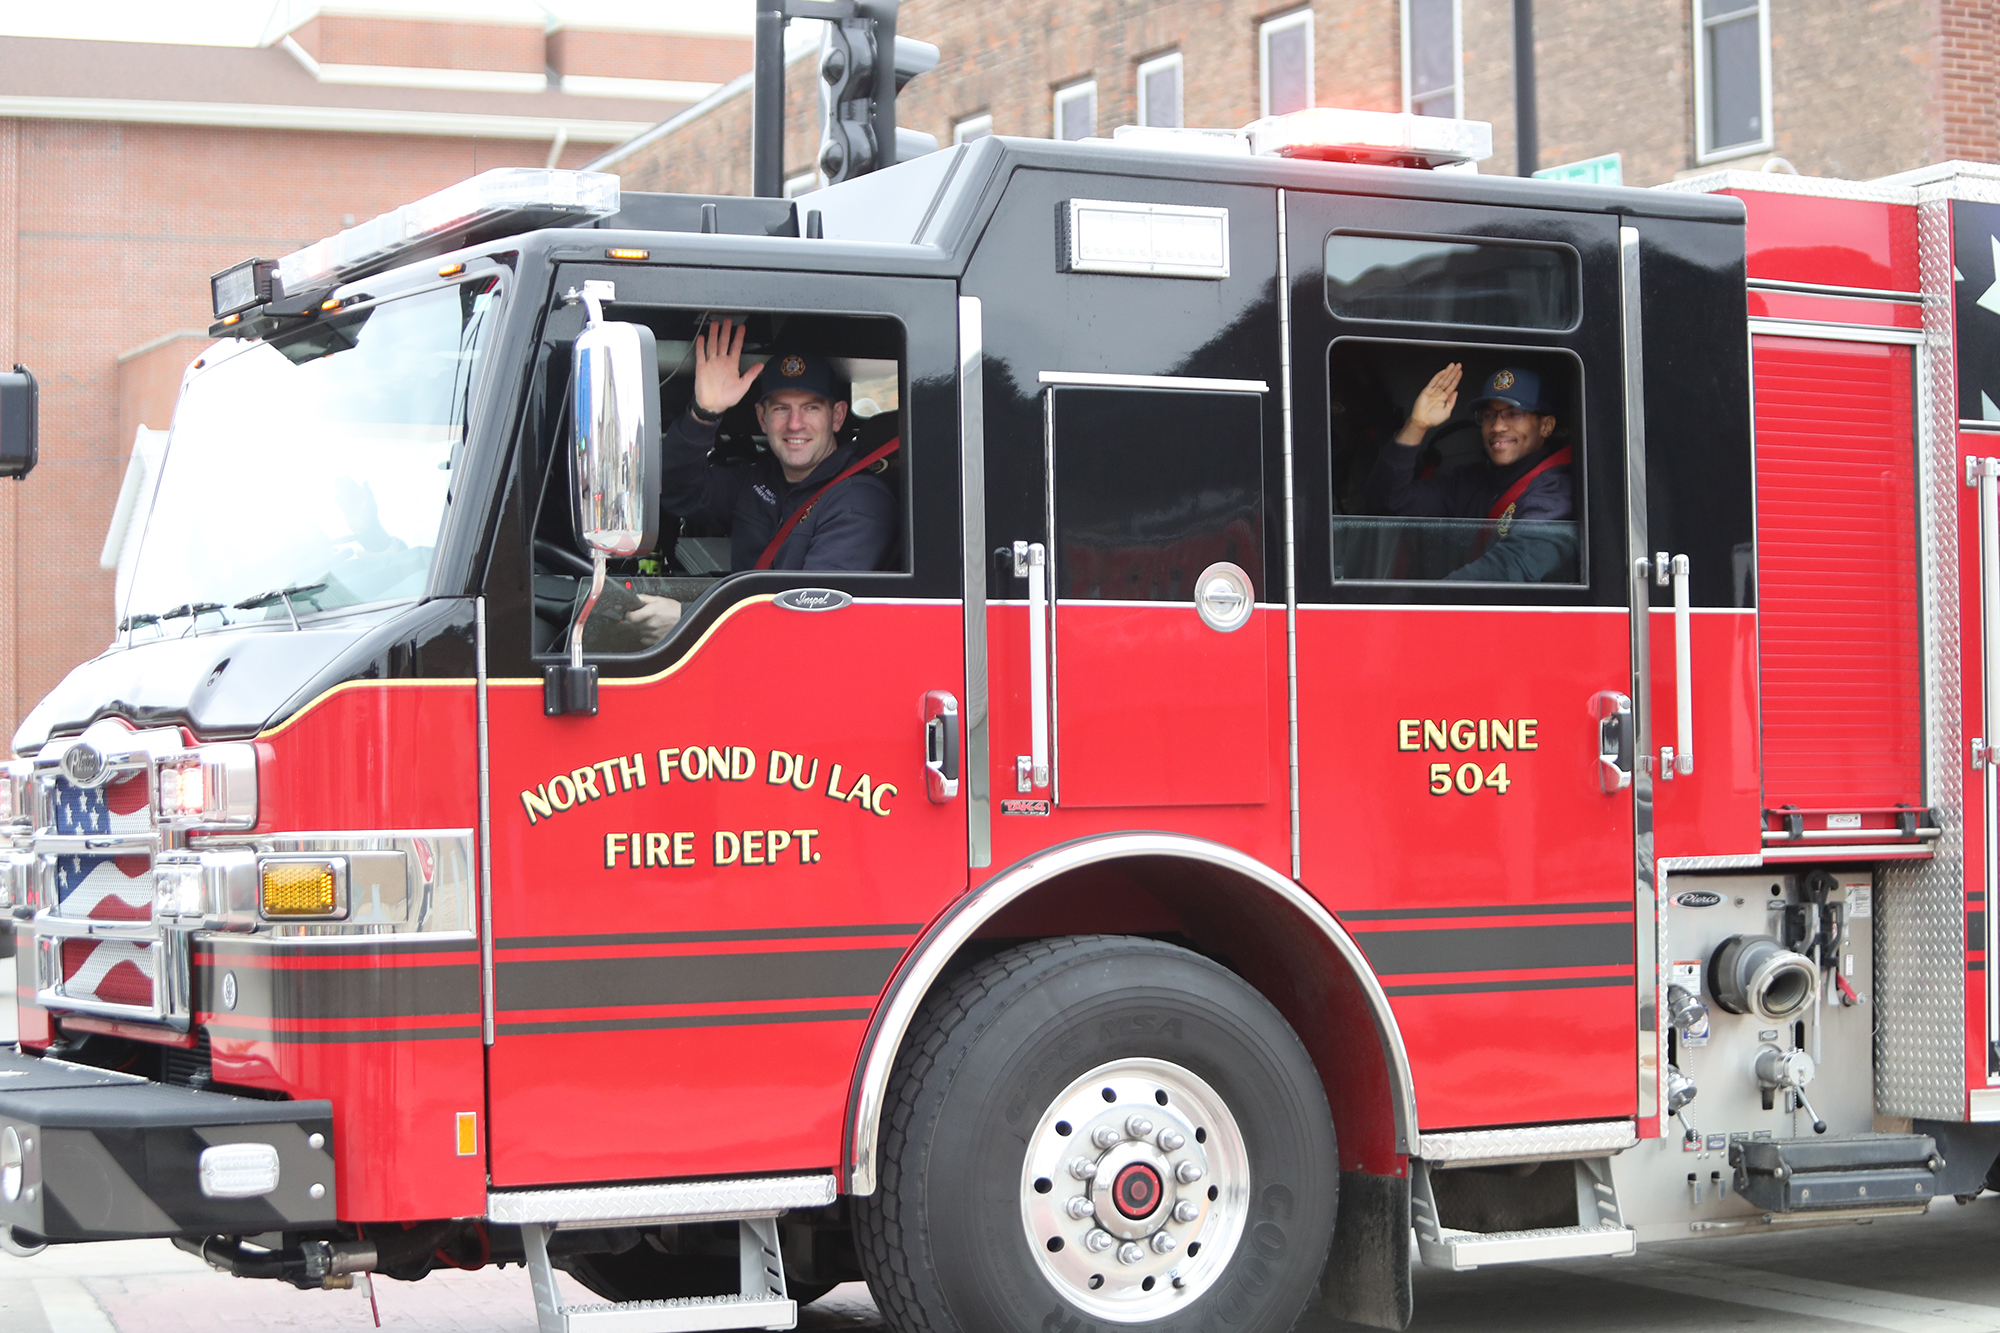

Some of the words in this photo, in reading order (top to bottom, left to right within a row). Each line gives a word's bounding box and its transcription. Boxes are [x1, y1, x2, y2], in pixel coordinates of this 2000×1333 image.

[795, 591, 830, 609] Impel
[1398, 718, 1539, 751] ENGINE
[519, 752, 647, 826] NORTH
[657, 745, 756, 784] FOND
[766, 749, 819, 791] DU
[825, 763, 898, 817] LAC
[1429, 762, 1511, 796] 504
[604, 832, 695, 868] FIRE
[713, 828, 821, 867] DEPT.
[1679, 893, 1719, 904] Pierce
[1098, 1013, 1183, 1043] MSA
